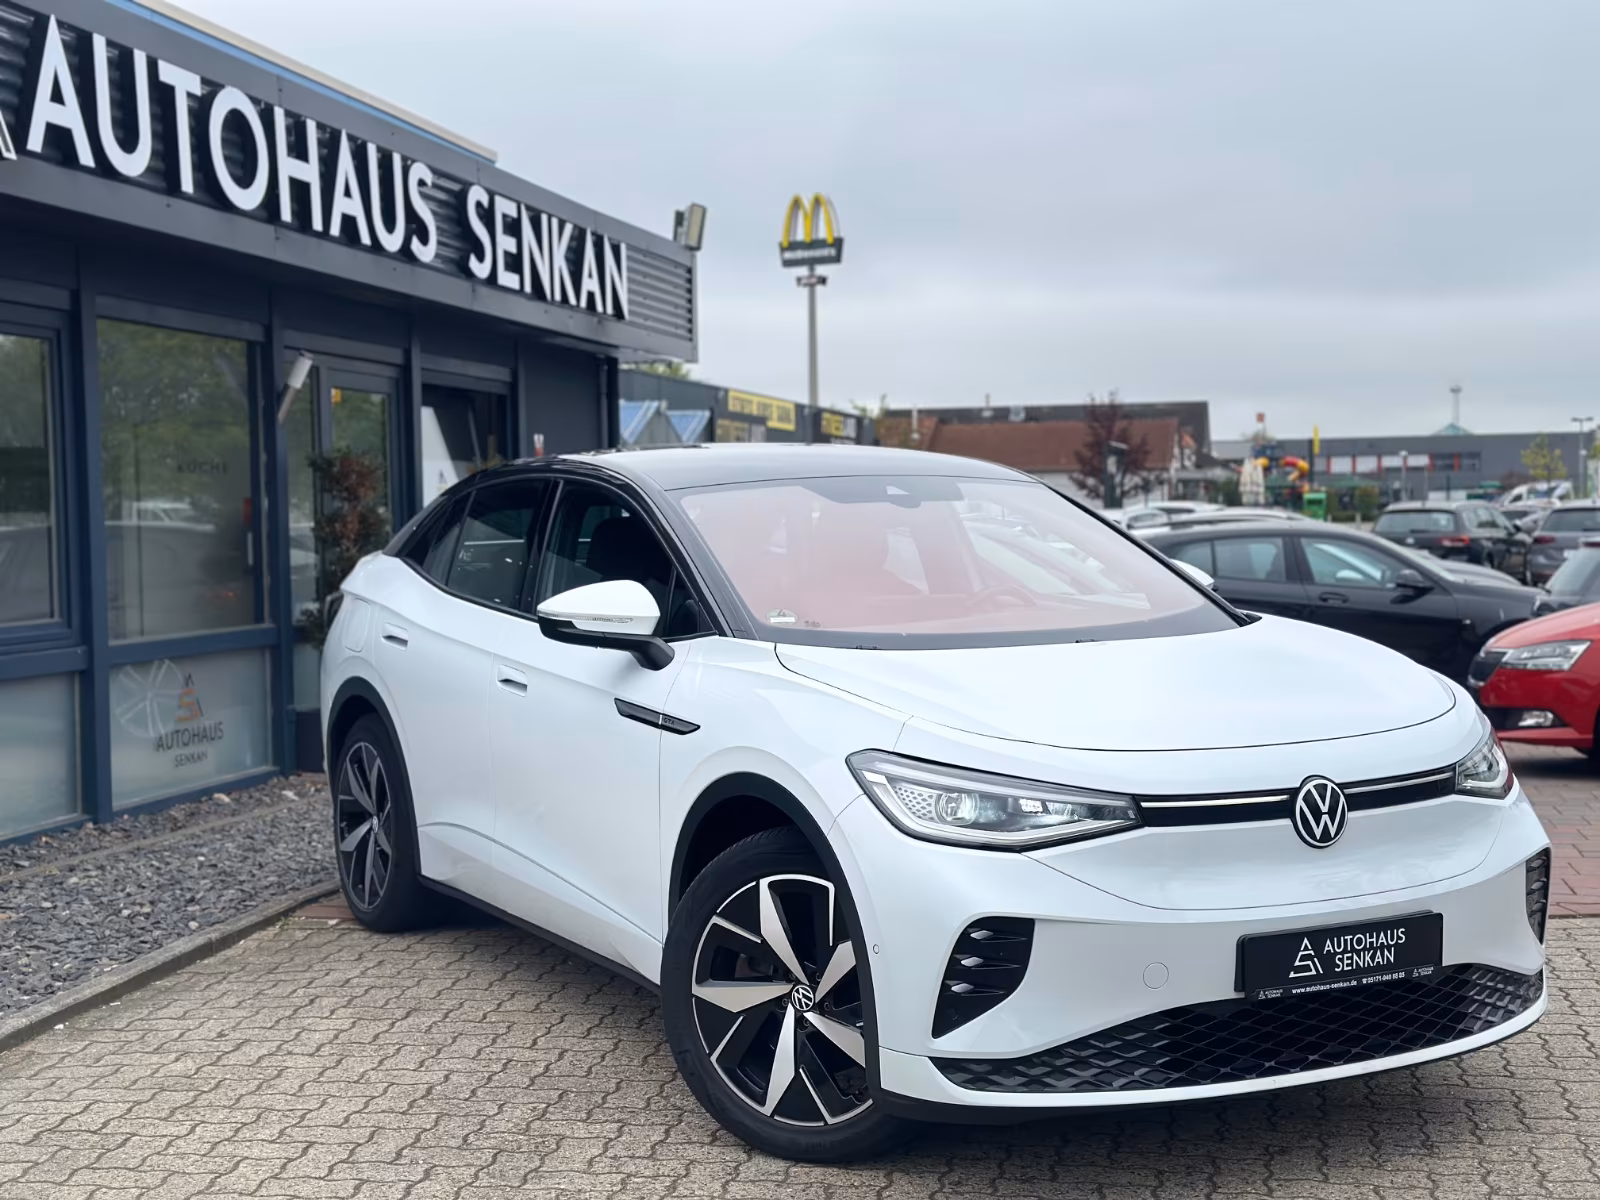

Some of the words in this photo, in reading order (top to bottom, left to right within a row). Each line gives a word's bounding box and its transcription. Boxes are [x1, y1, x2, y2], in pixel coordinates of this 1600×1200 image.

[26, 14, 438, 263] AUTOHAUS
[466, 183, 630, 320] SENKAN
[156, 721, 225, 752] AUTOHAUS
[174, 750, 208, 767] SENKAN
[1323, 928, 1406, 955] AUTOHAUS
[1334, 947, 1395, 972] SENKAN
